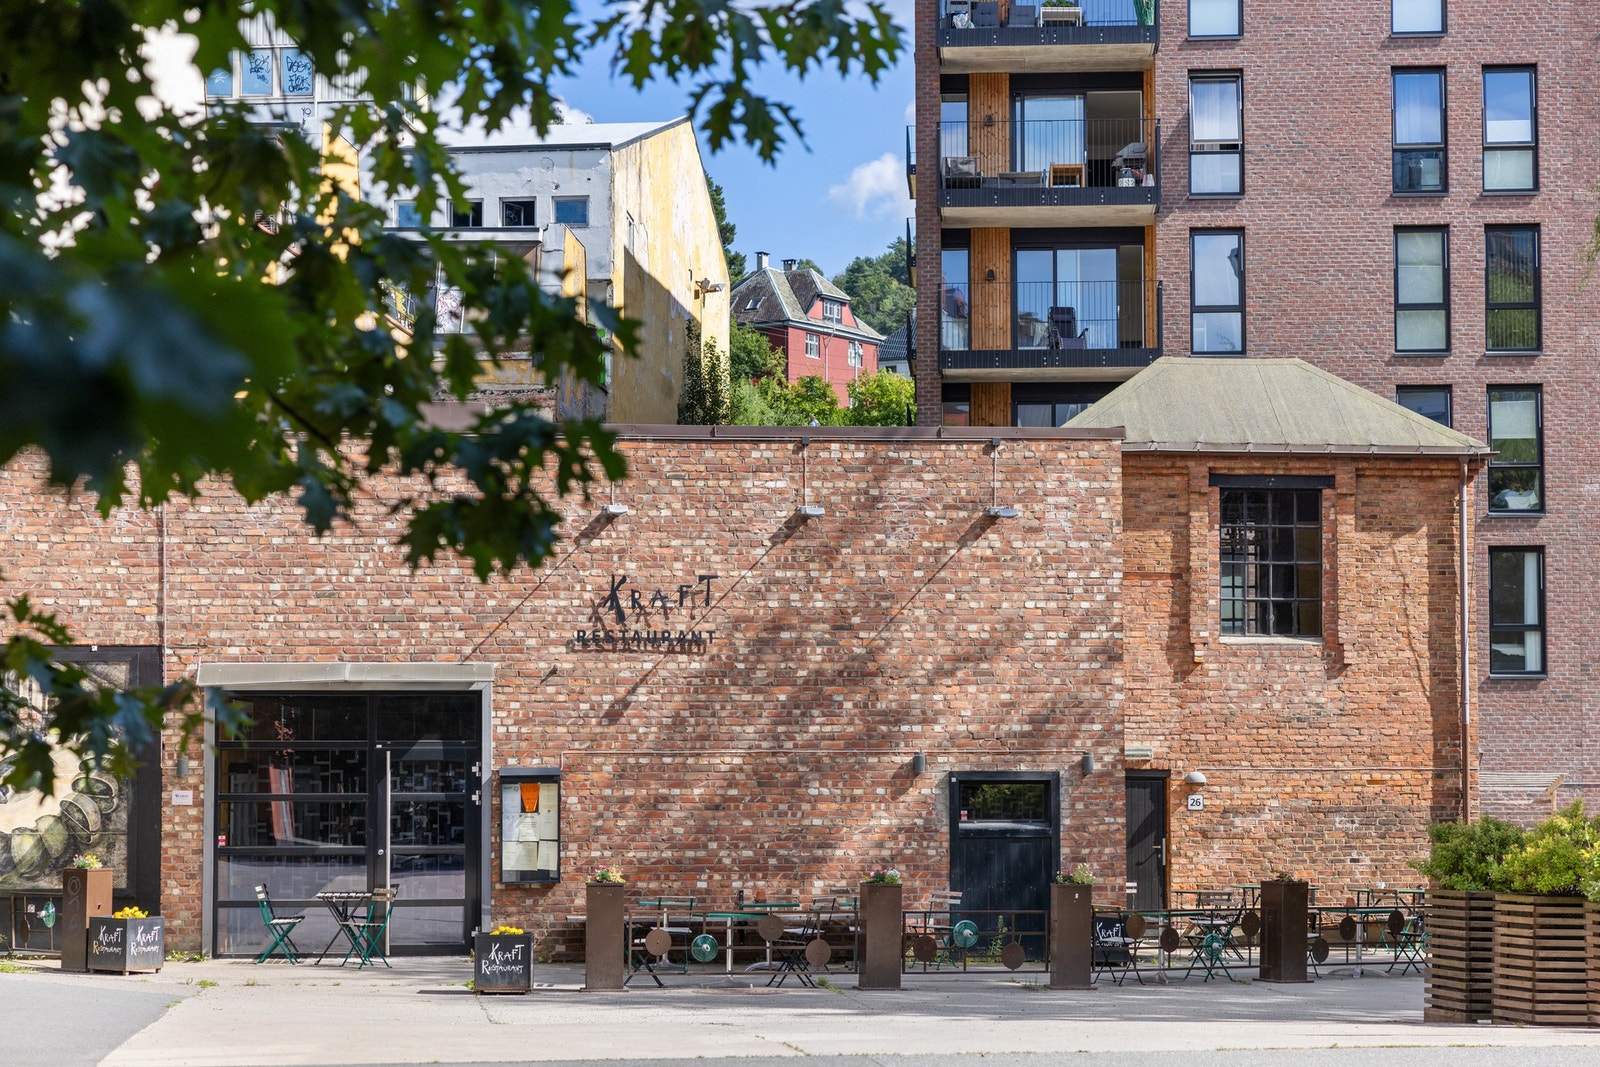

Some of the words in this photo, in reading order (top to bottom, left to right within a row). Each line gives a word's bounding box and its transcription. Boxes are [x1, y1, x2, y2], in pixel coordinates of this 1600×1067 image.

[602, 574, 719, 623] KRAFT
[576, 629, 716, 644] RESTAURANT
[1190, 798, 1201, 807] 26
[98, 925, 124, 946] KRAFT
[136, 925, 161, 946] KRAFT
[488, 943, 525, 965] KRAFT
